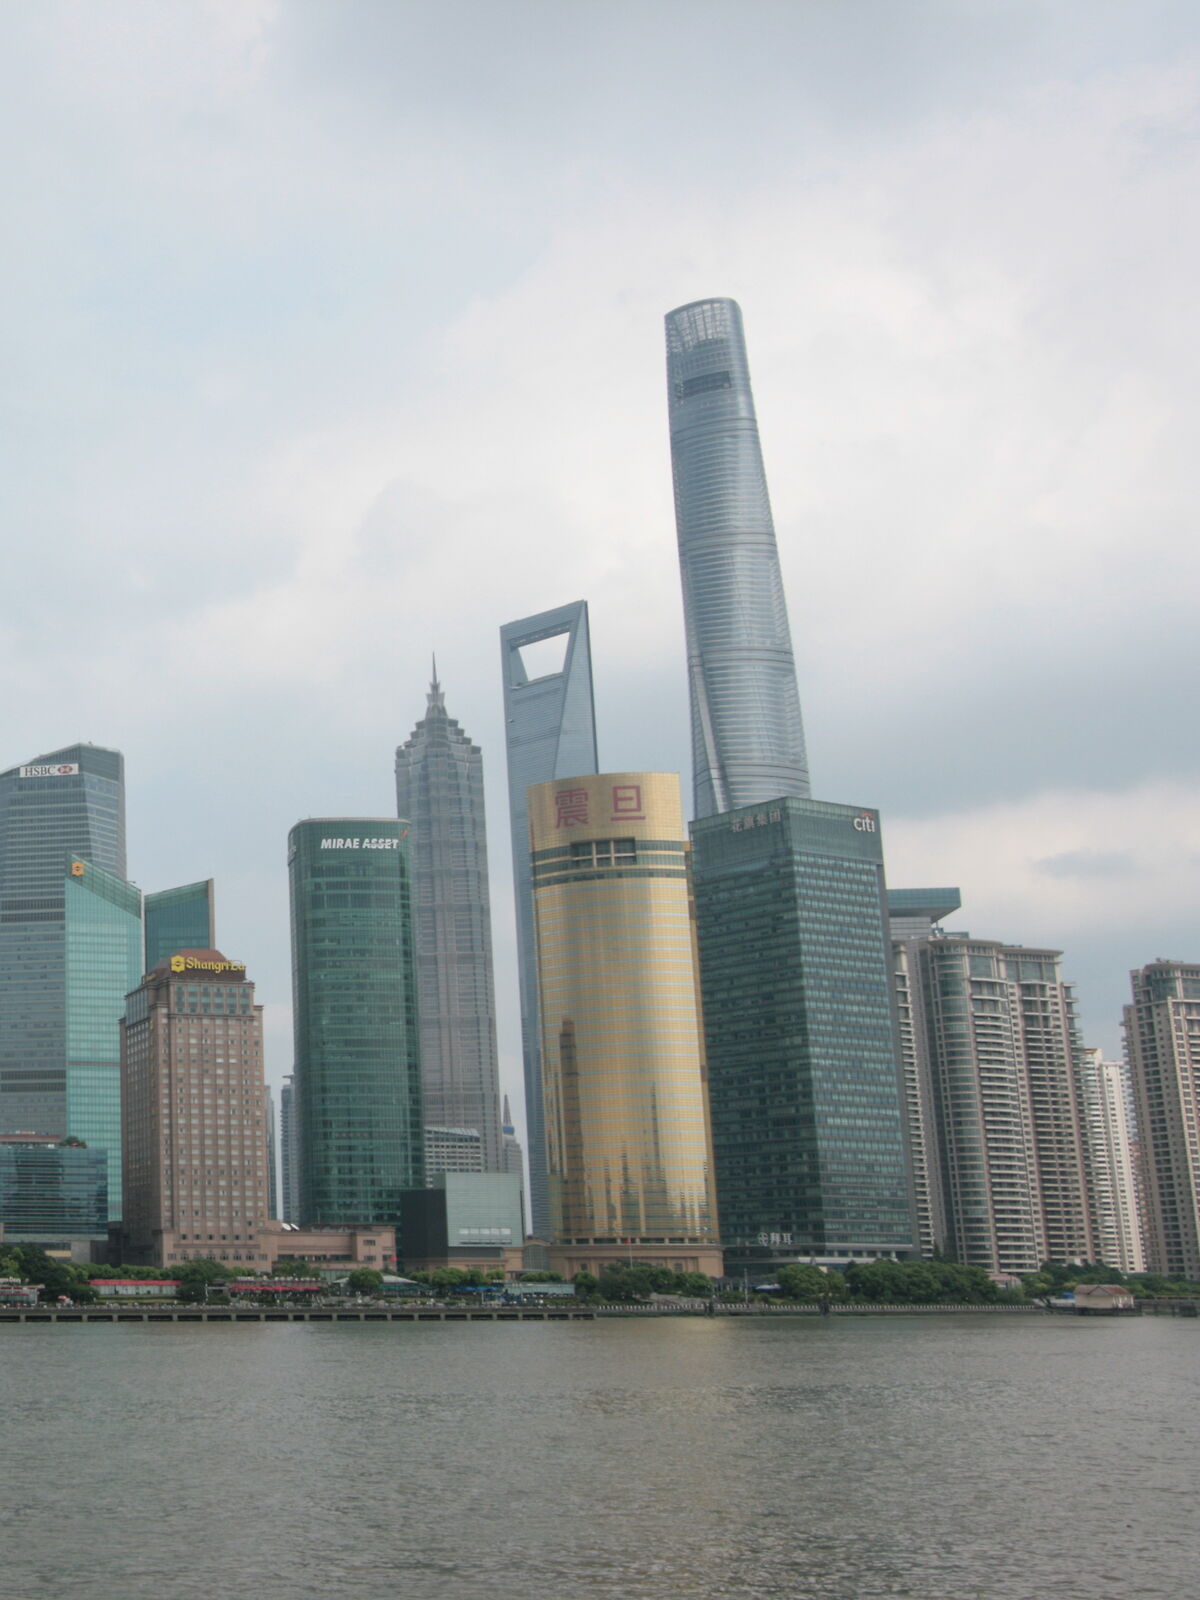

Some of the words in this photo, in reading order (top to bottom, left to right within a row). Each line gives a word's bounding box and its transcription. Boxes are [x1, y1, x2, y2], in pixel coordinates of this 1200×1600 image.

[24, 766, 56, 777] HSBC
[555, 785, 646, 829] 震旦
[853, 814, 876, 833] citi
[320, 838, 360, 849] MIRAE
[362, 838, 399, 849] ASSET
